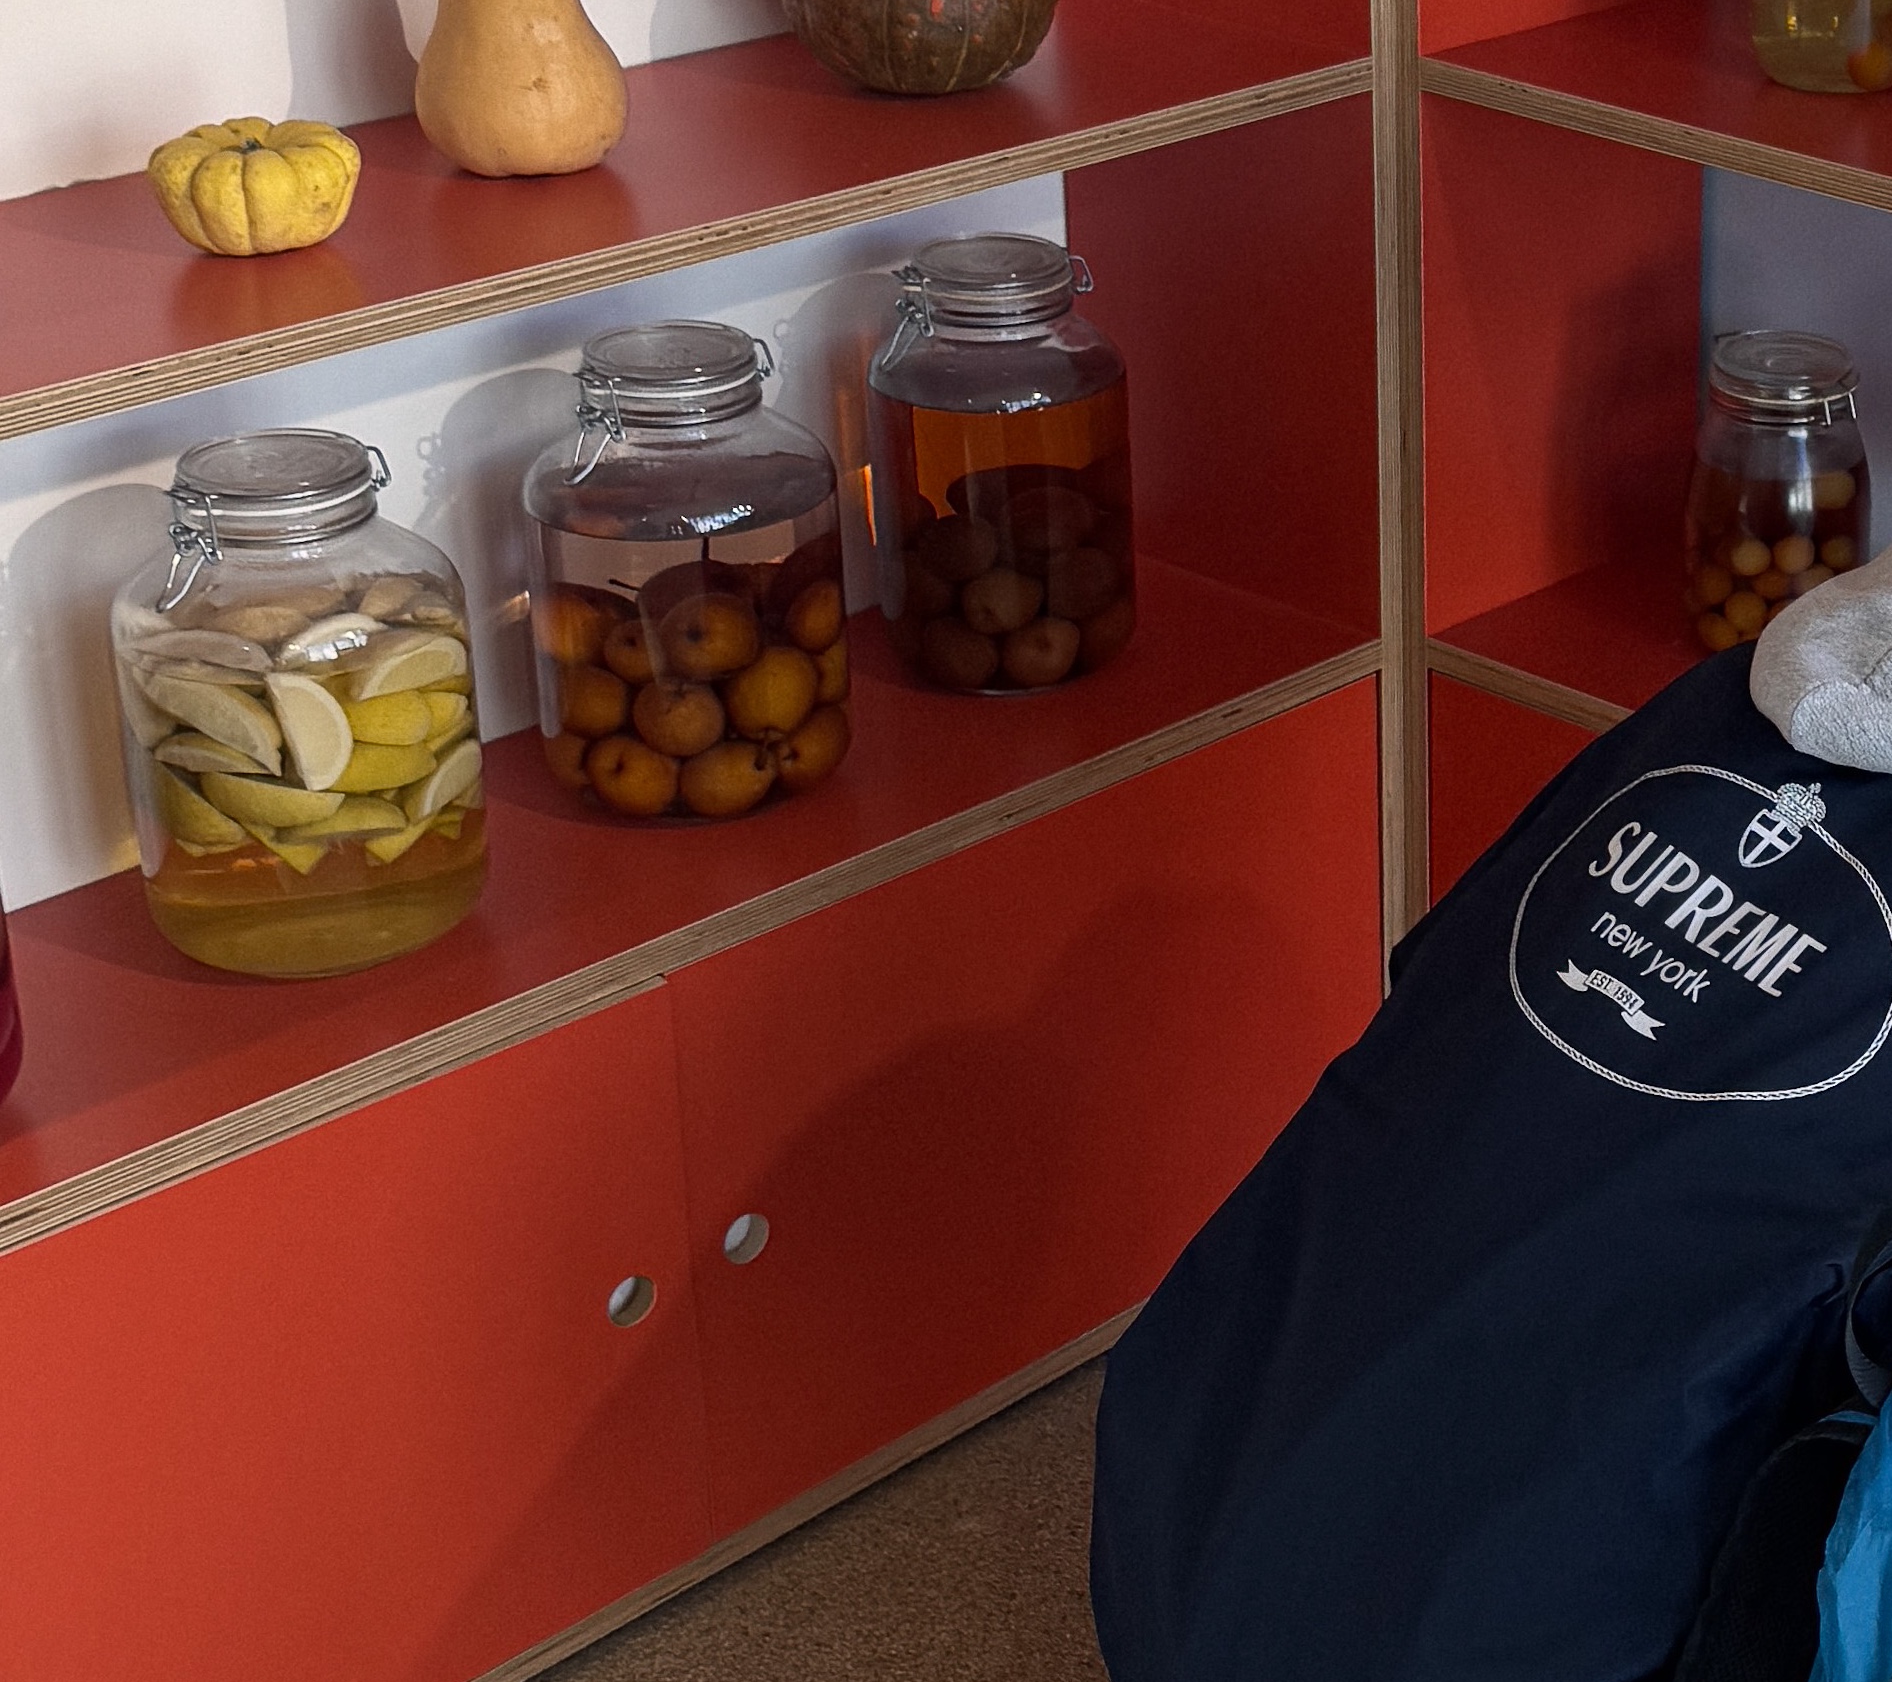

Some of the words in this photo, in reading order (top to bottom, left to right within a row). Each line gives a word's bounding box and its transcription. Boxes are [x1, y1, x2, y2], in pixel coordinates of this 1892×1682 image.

[1588, 821, 1828, 998] SUPREME
[1590, 911, 1654, 959] new
[1639, 948, 1711, 1004] york
